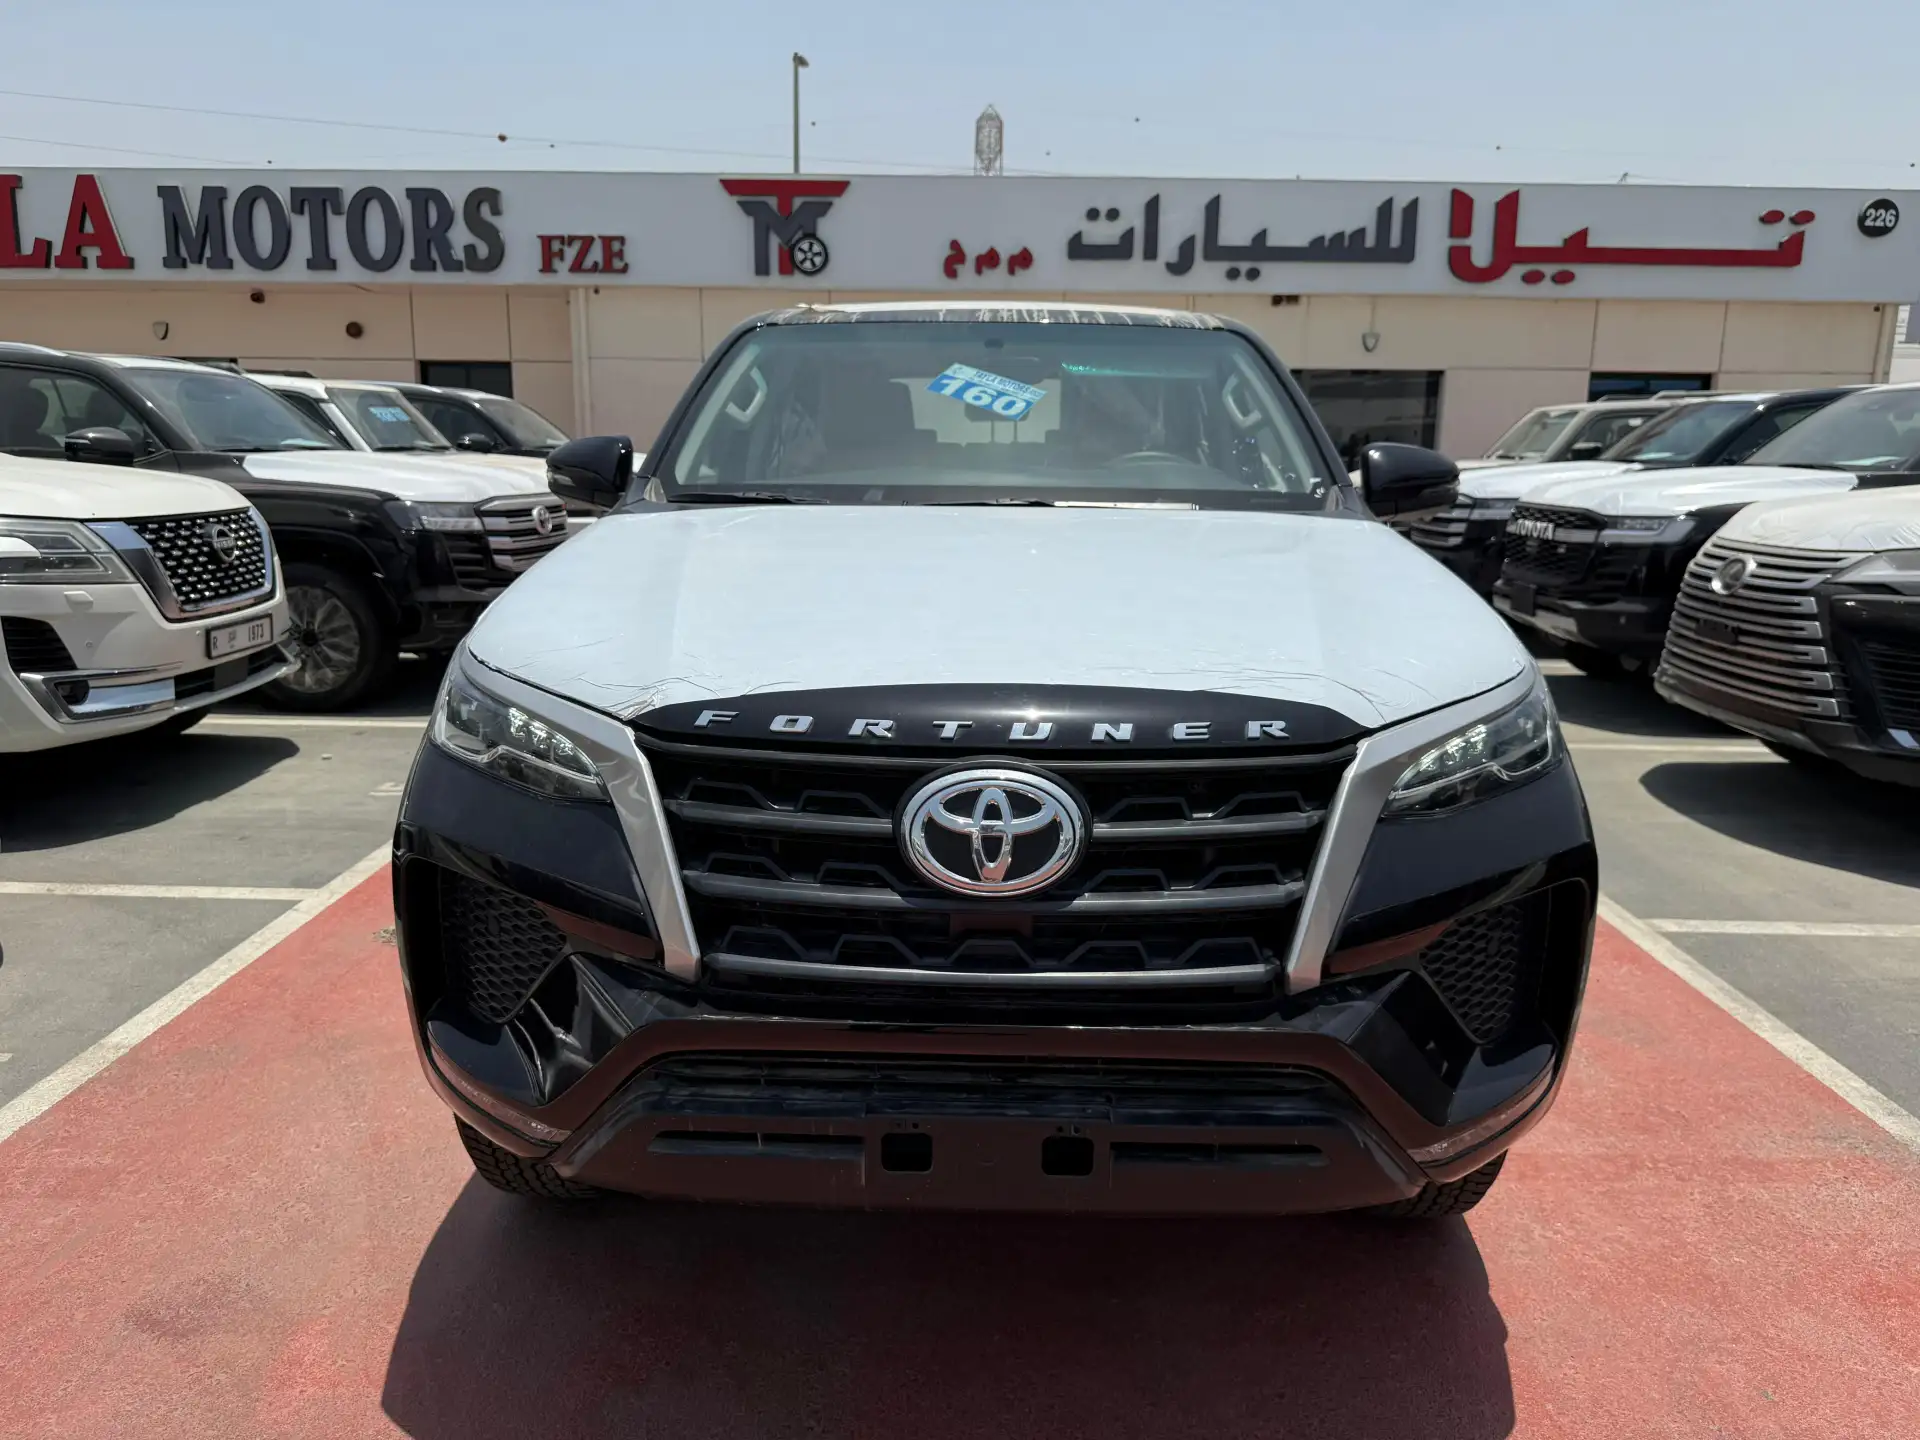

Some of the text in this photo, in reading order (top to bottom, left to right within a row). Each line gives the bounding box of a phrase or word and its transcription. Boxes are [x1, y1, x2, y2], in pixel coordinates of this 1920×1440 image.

[157, 185, 506, 272] MOTORS
[537, 234, 629, 274] FZE
[1447, 188, 1816, 284] تيلا
[1863, 207, 1897, 228] 226
[1067, 193, 1419, 281] للسيارات
[939, 378, 1027, 416] 160
[1516, 518, 1554, 540] TOYOTA
[693, 709, 1290, 742] FORTUNER
